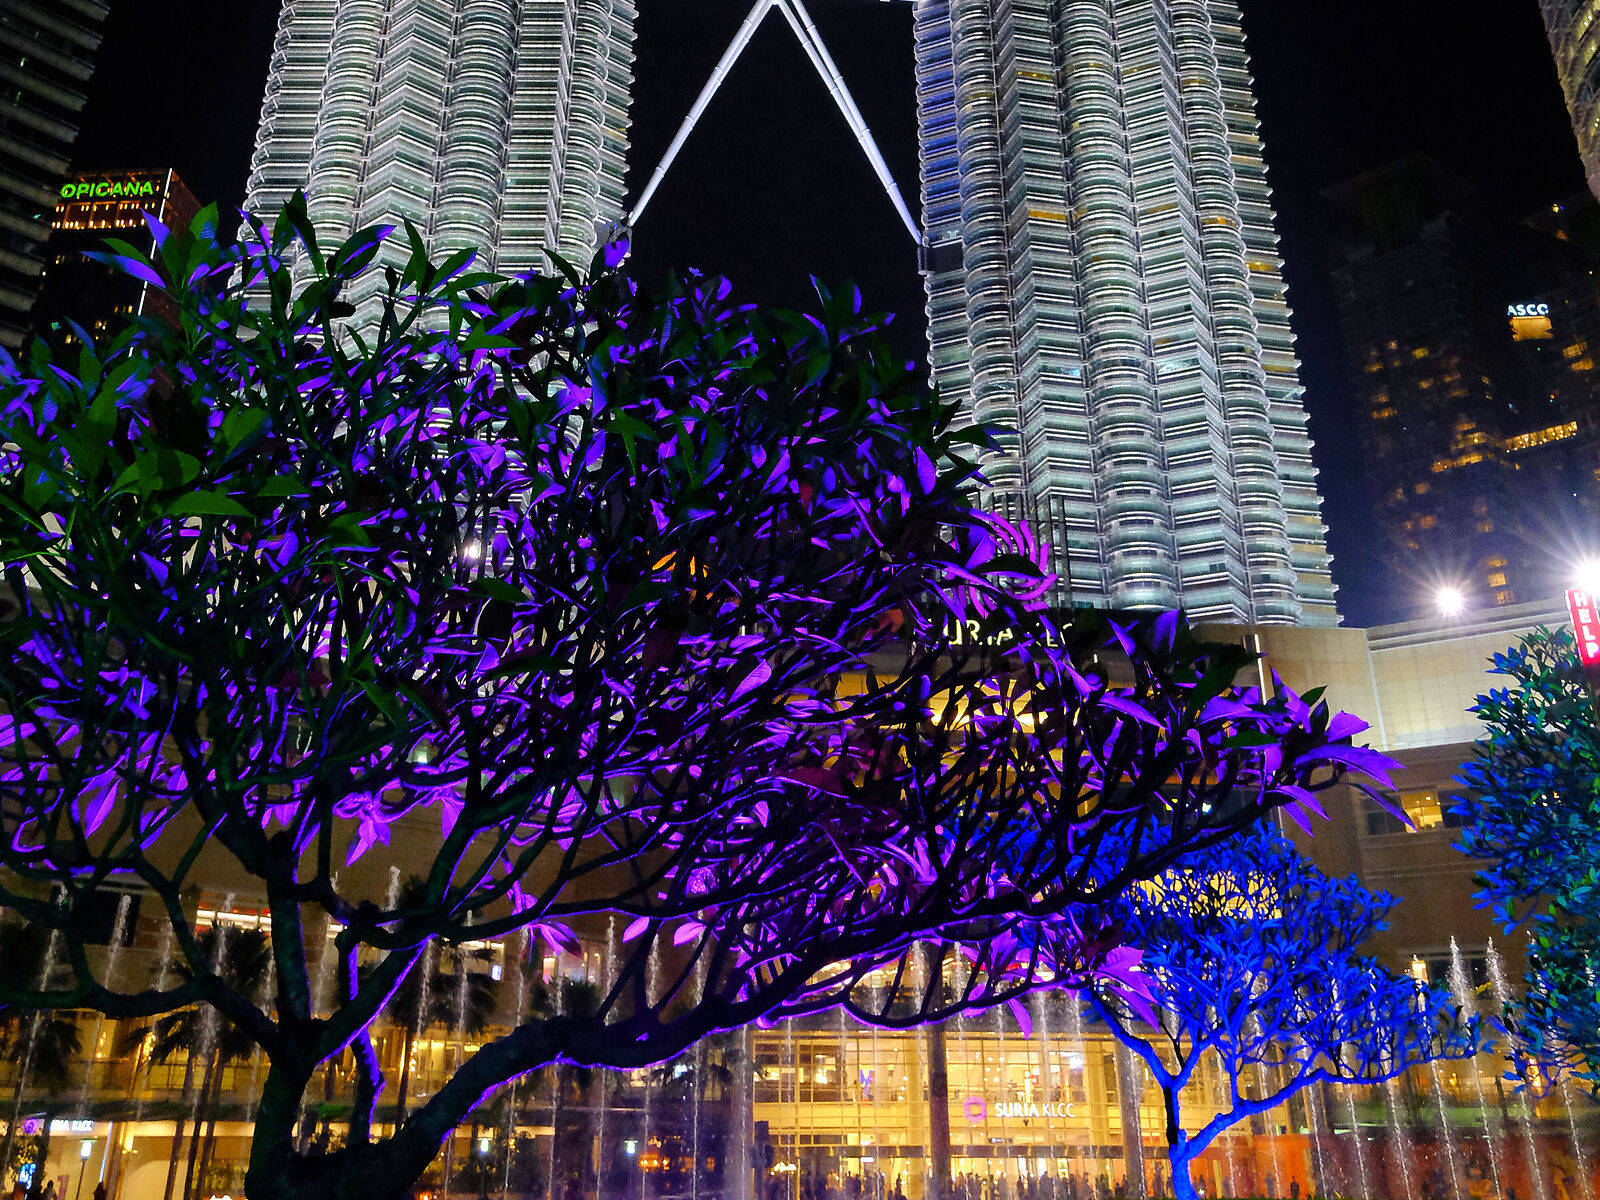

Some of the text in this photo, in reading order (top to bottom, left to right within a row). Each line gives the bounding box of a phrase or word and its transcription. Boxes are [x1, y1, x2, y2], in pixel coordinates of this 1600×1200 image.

[60, 181, 154, 199] OPICANA
[1574, 592, 1599, 658] HELP
[994, 1102, 1075, 1118] SURIA KLCC
